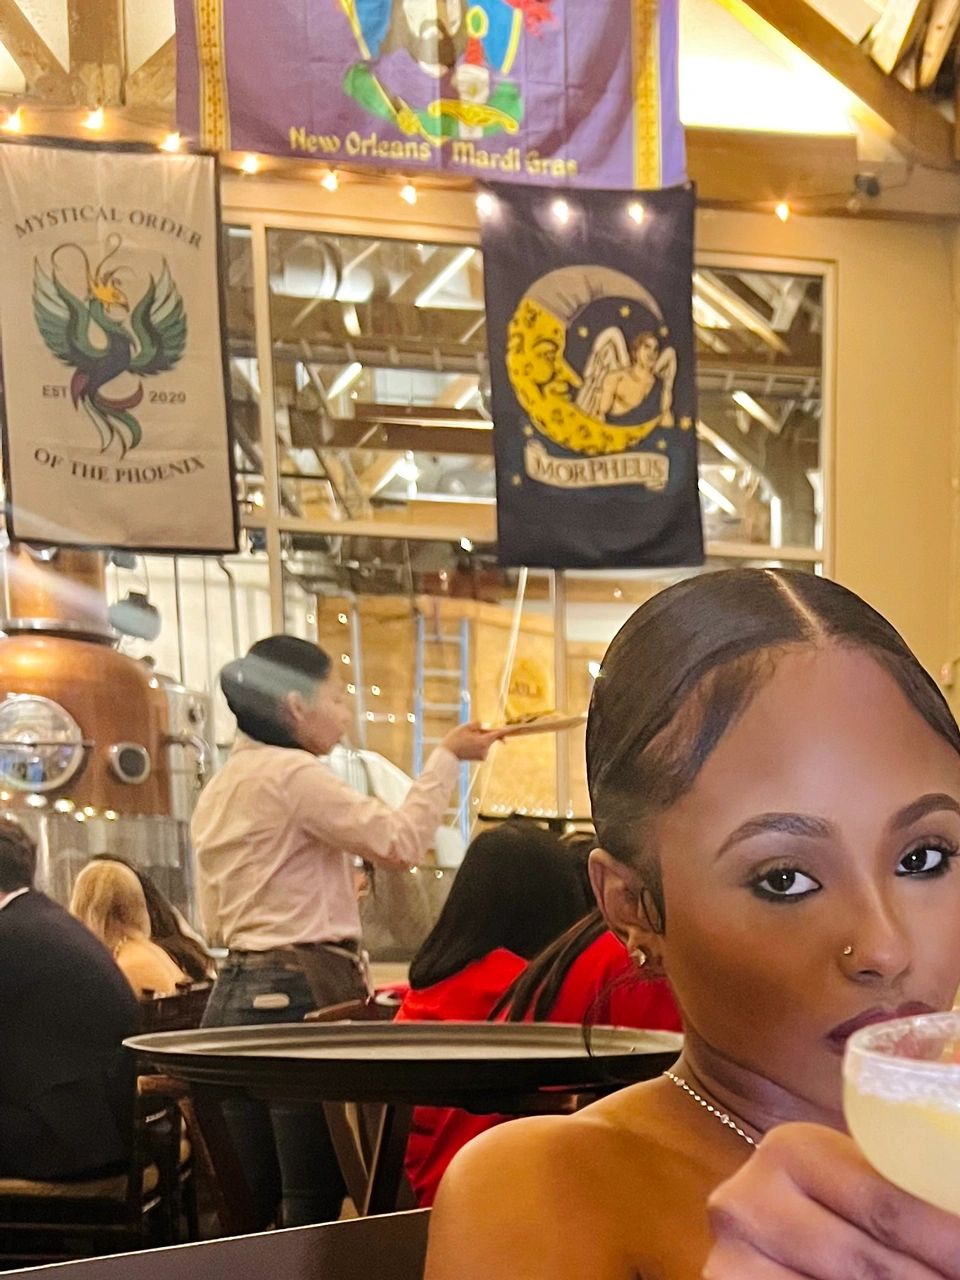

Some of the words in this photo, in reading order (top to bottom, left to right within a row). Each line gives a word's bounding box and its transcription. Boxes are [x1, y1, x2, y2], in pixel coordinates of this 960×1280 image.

[289, 126, 341, 153] New
[345, 131, 432, 161] Orleans
[452, 140, 521, 172] Mardi
[526, 151, 578, 177] Gras
[14, 205, 123, 239] MYSTICAL
[129, 209, 202, 249] ORDER
[42, 384, 68, 399] EST
[149, 390, 187, 404] 2020
[34, 447, 63, 469] OF
[70, 460, 110, 482] THE
[115, 455, 205, 484] PHOENIX
[535, 456, 664, 484] MORPHEUS
